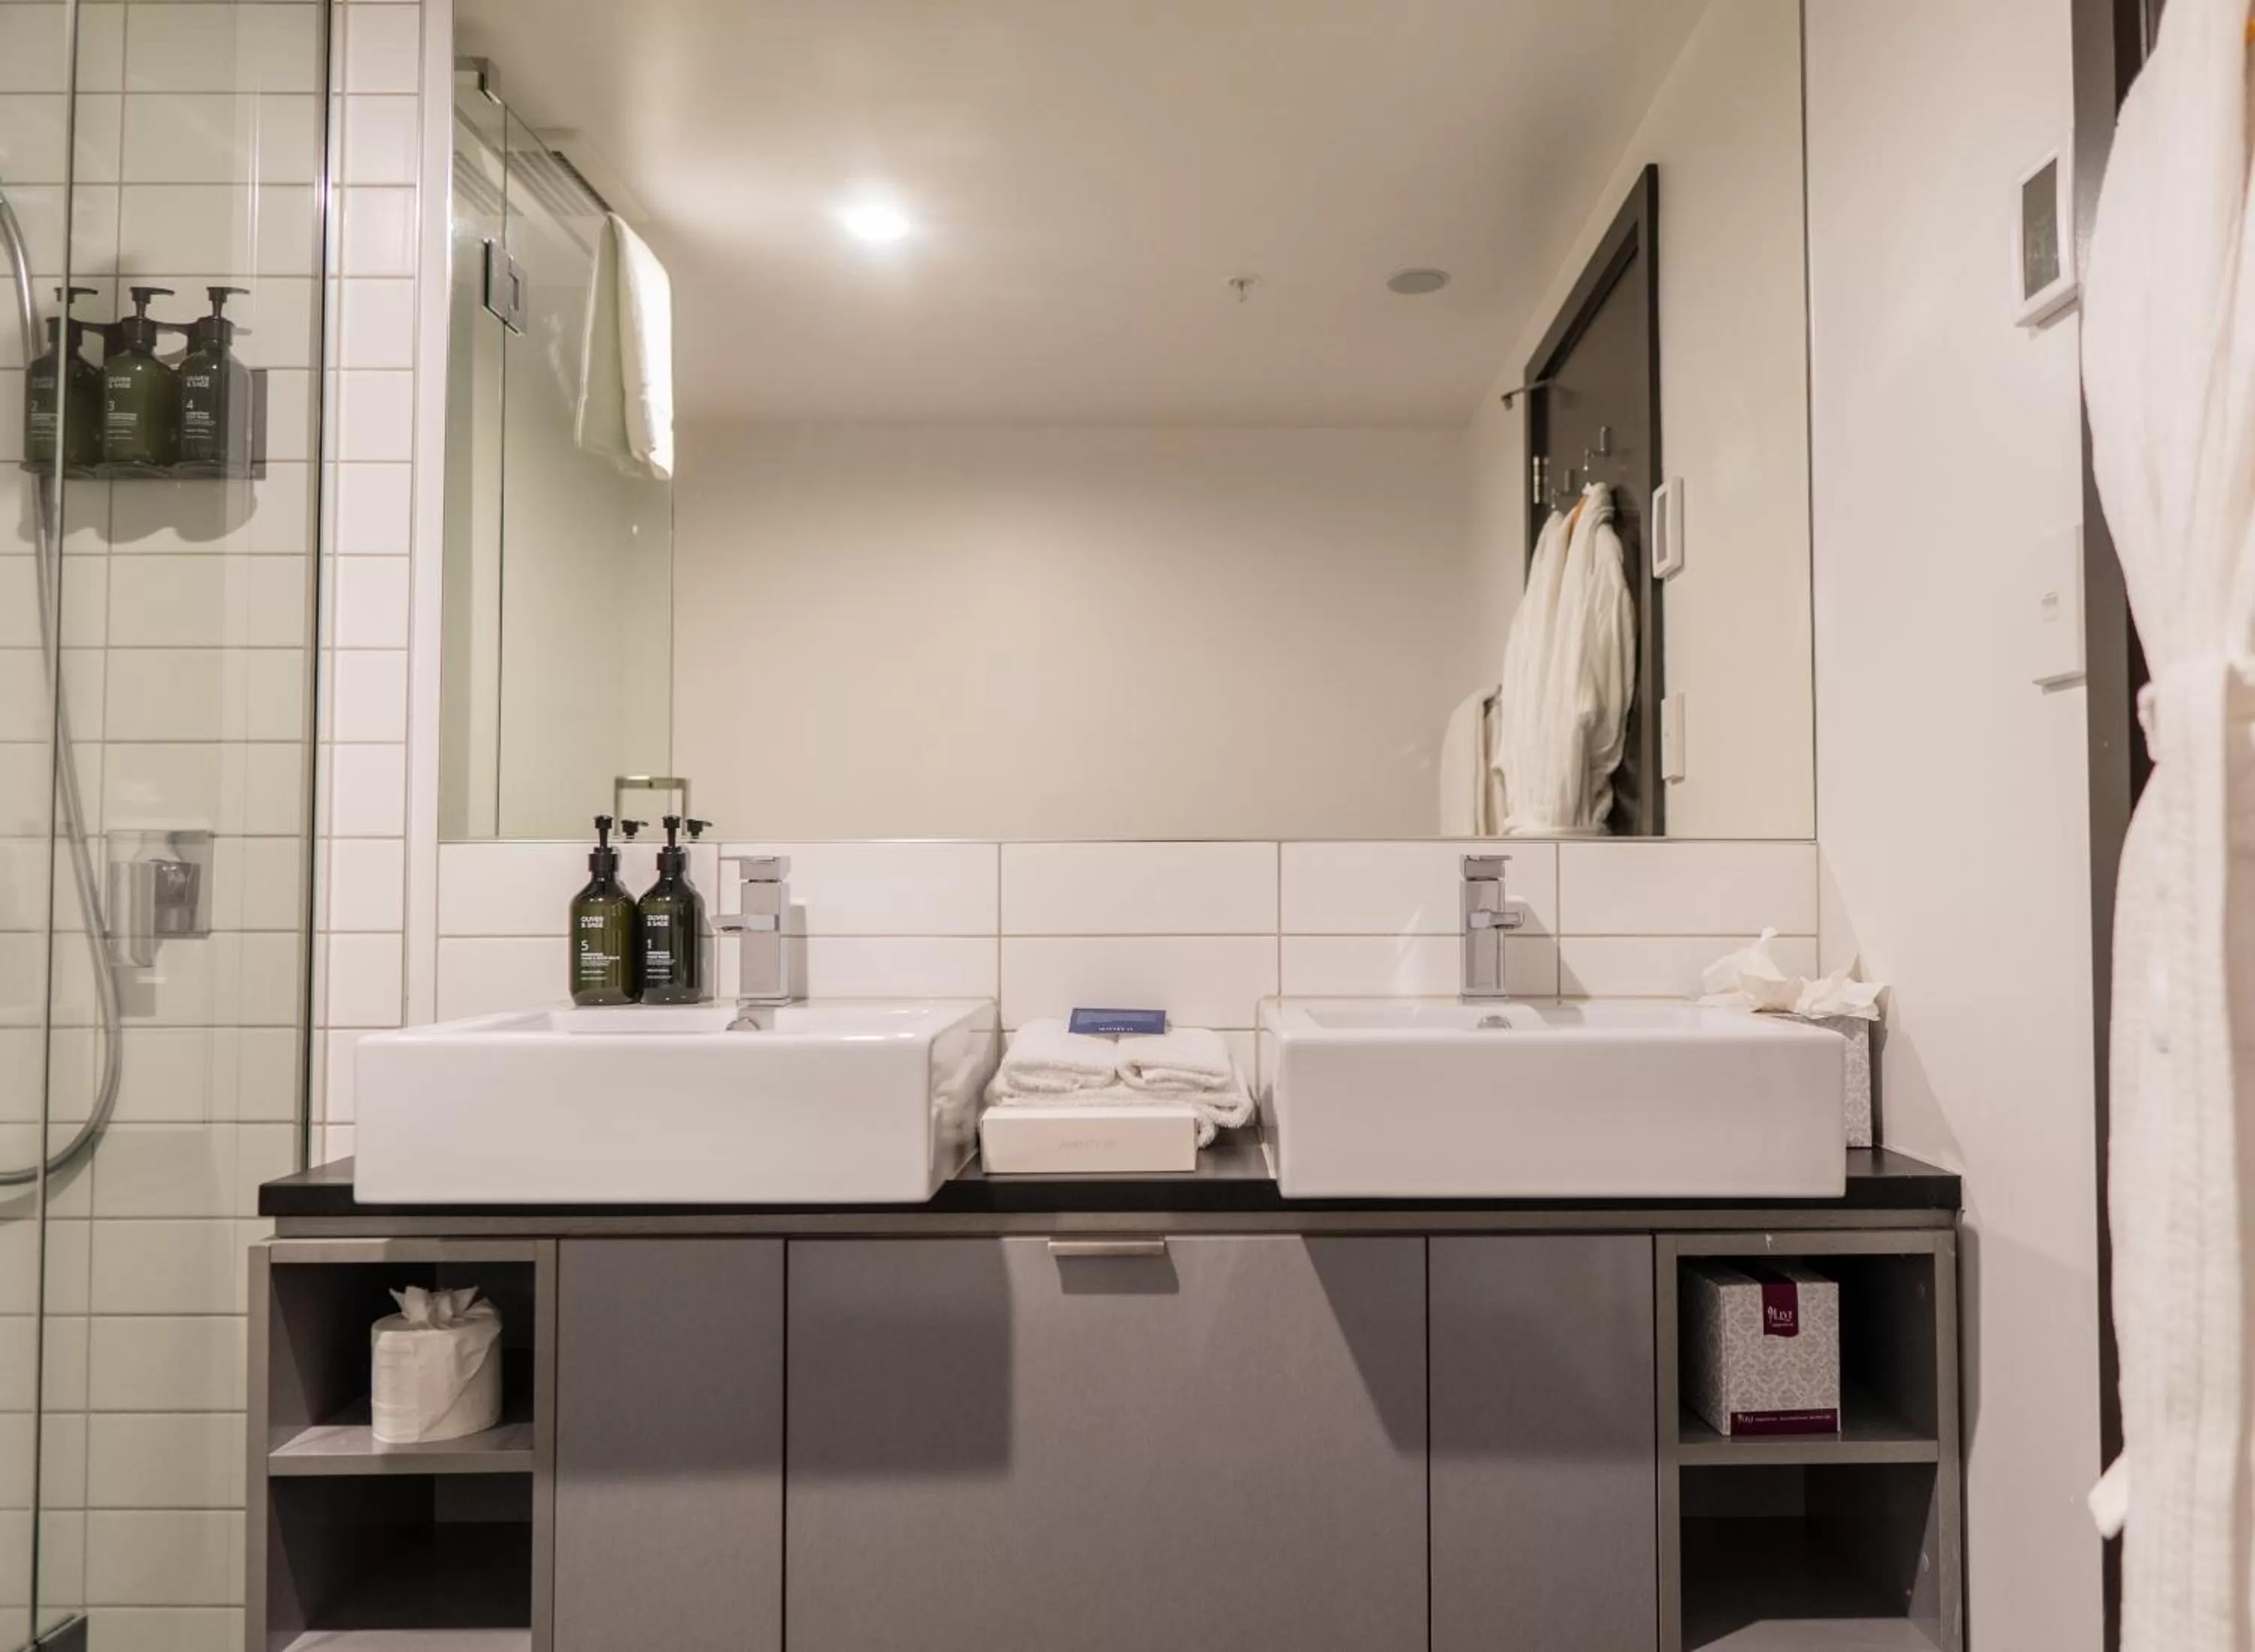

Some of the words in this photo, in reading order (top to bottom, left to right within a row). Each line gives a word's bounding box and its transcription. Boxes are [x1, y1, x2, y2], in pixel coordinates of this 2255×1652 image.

[107, 400, 115, 411] 3
[186, 399, 193, 410] 4
[581, 939, 589, 951] 5
[646, 939, 652, 949] 1
